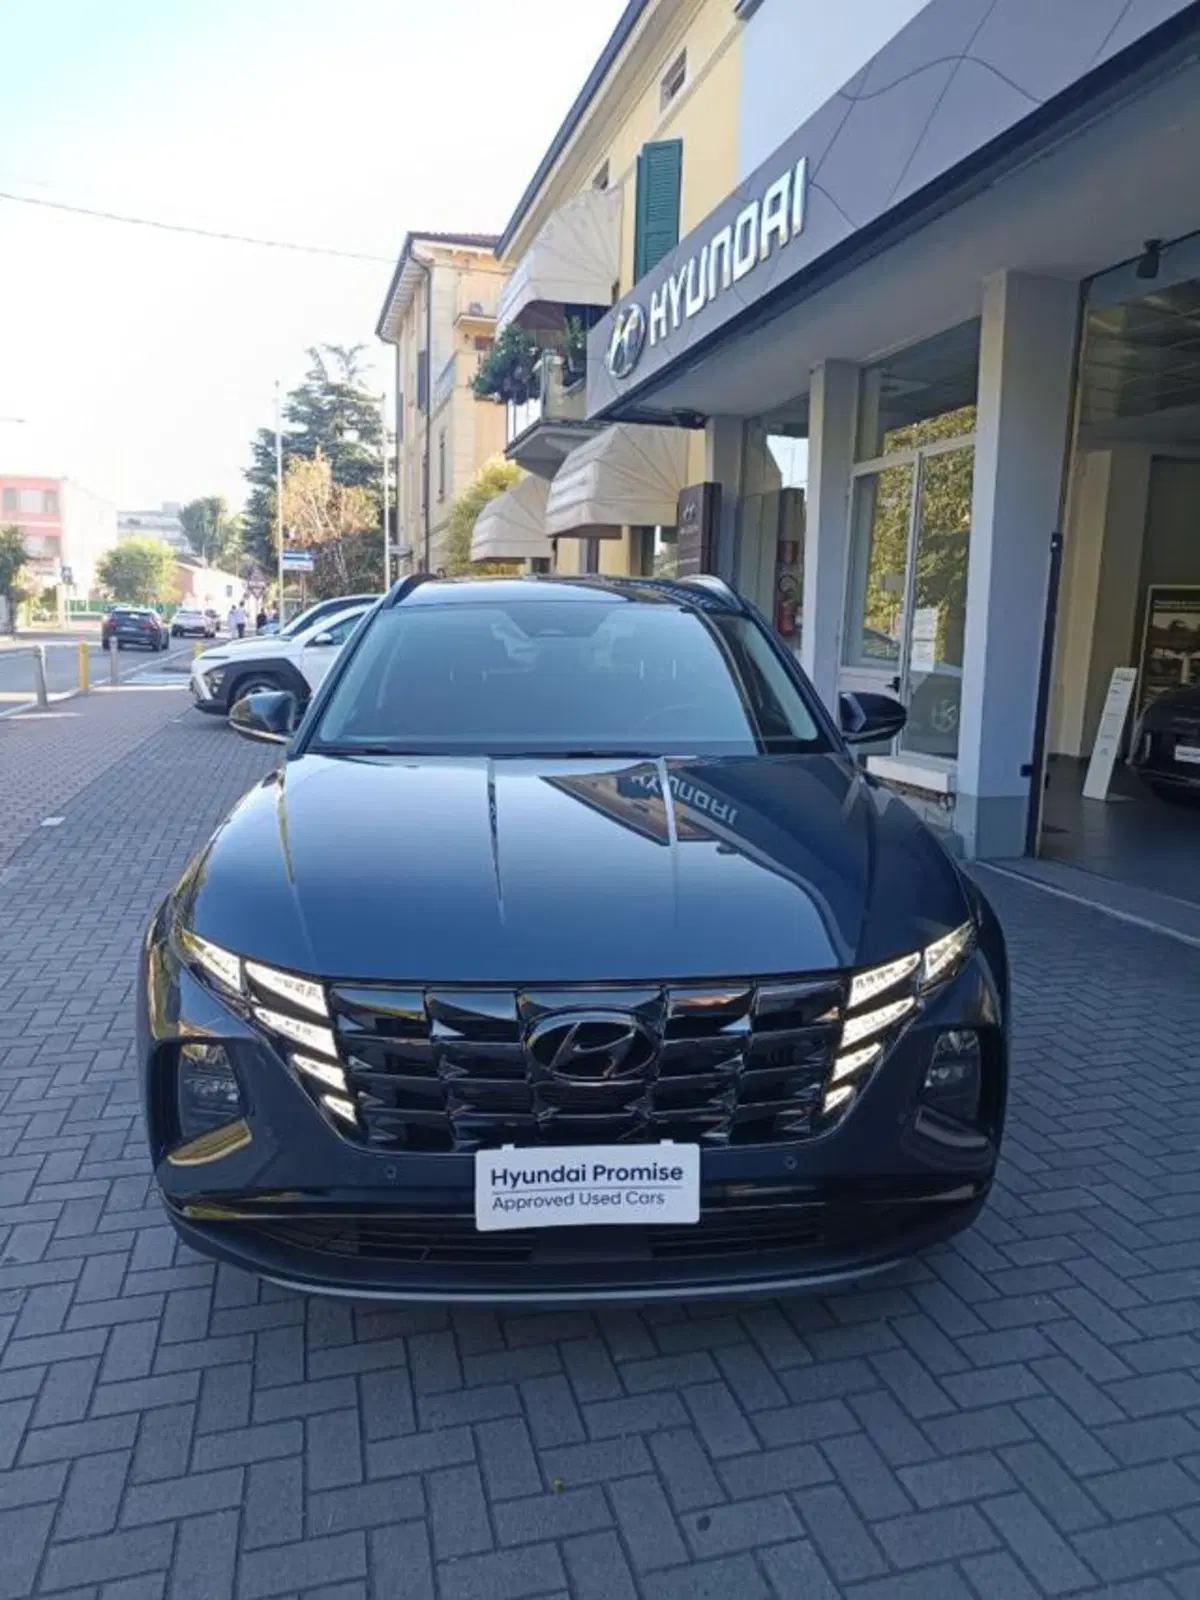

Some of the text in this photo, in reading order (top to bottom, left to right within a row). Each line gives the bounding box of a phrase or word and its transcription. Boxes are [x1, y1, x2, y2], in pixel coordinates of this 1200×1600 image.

[650, 156, 807, 346] HYUNDAI
[491, 1162, 683, 1188] Hyundai Promise
[492, 1190, 665, 1212] Approved Used Cars
